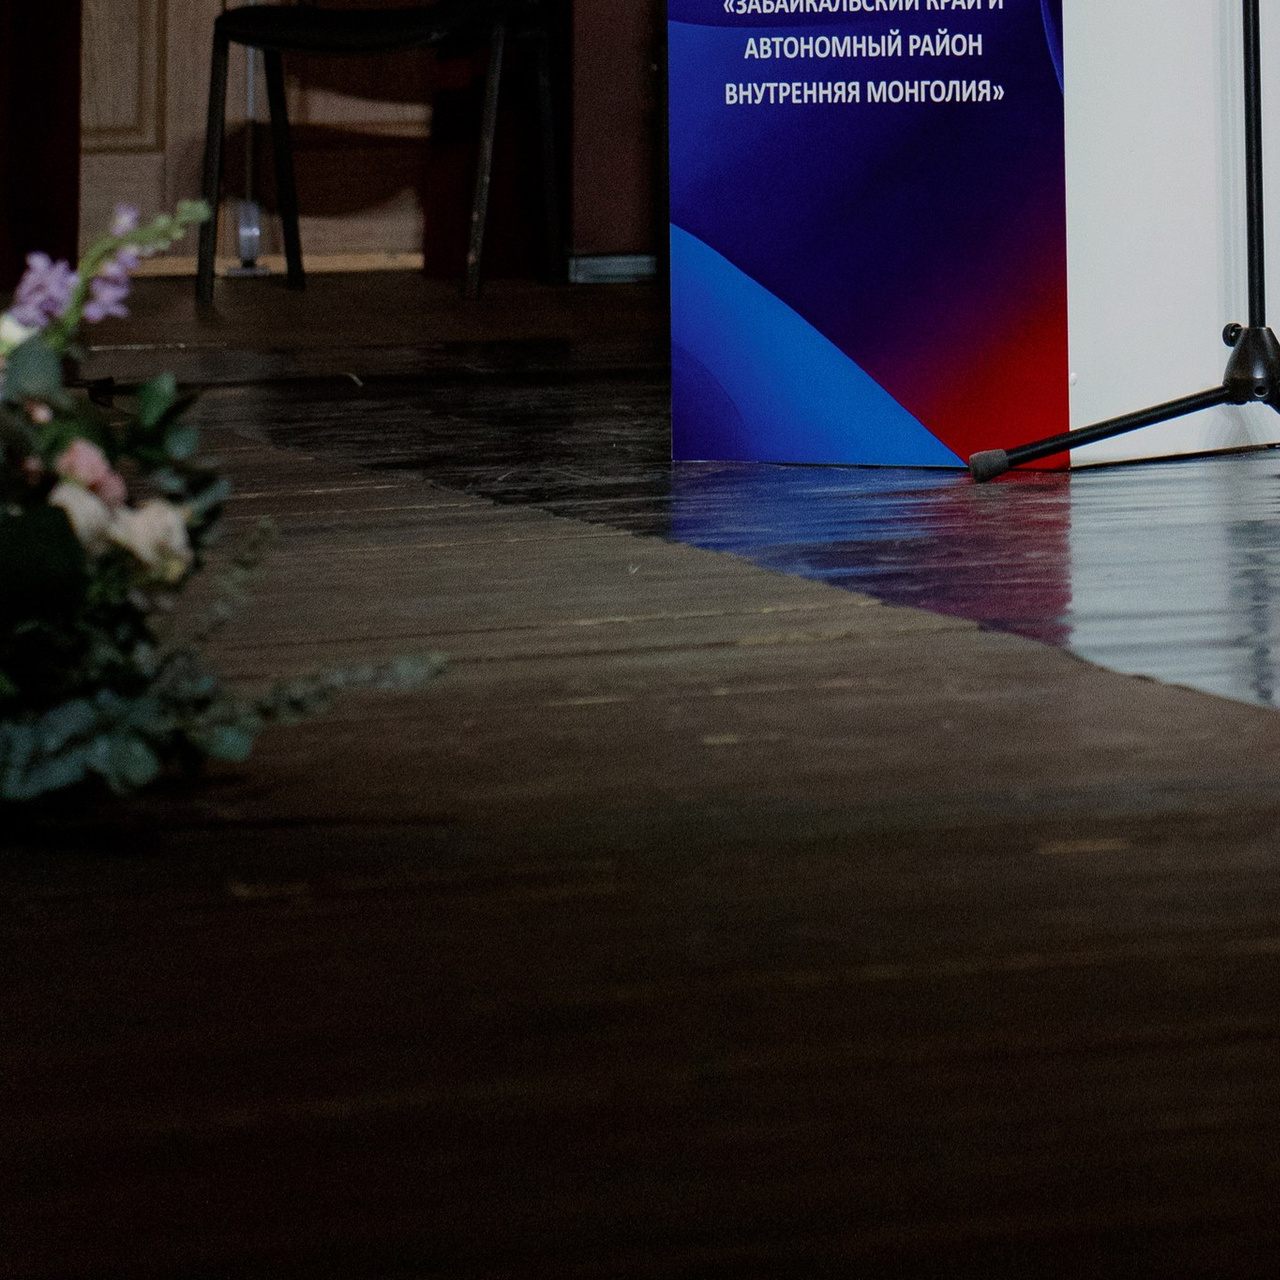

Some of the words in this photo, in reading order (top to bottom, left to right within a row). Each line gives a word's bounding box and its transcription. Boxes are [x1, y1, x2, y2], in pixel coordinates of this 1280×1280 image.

[744, 29, 902, 59] АВТОНОМНЫЙ
[908, 28, 983, 57] РАЙОН
[725, 81, 861, 105] ВНУТРЕННЯЯ
[866, 79, 1005, 103] МОНГОЛИЯ»
